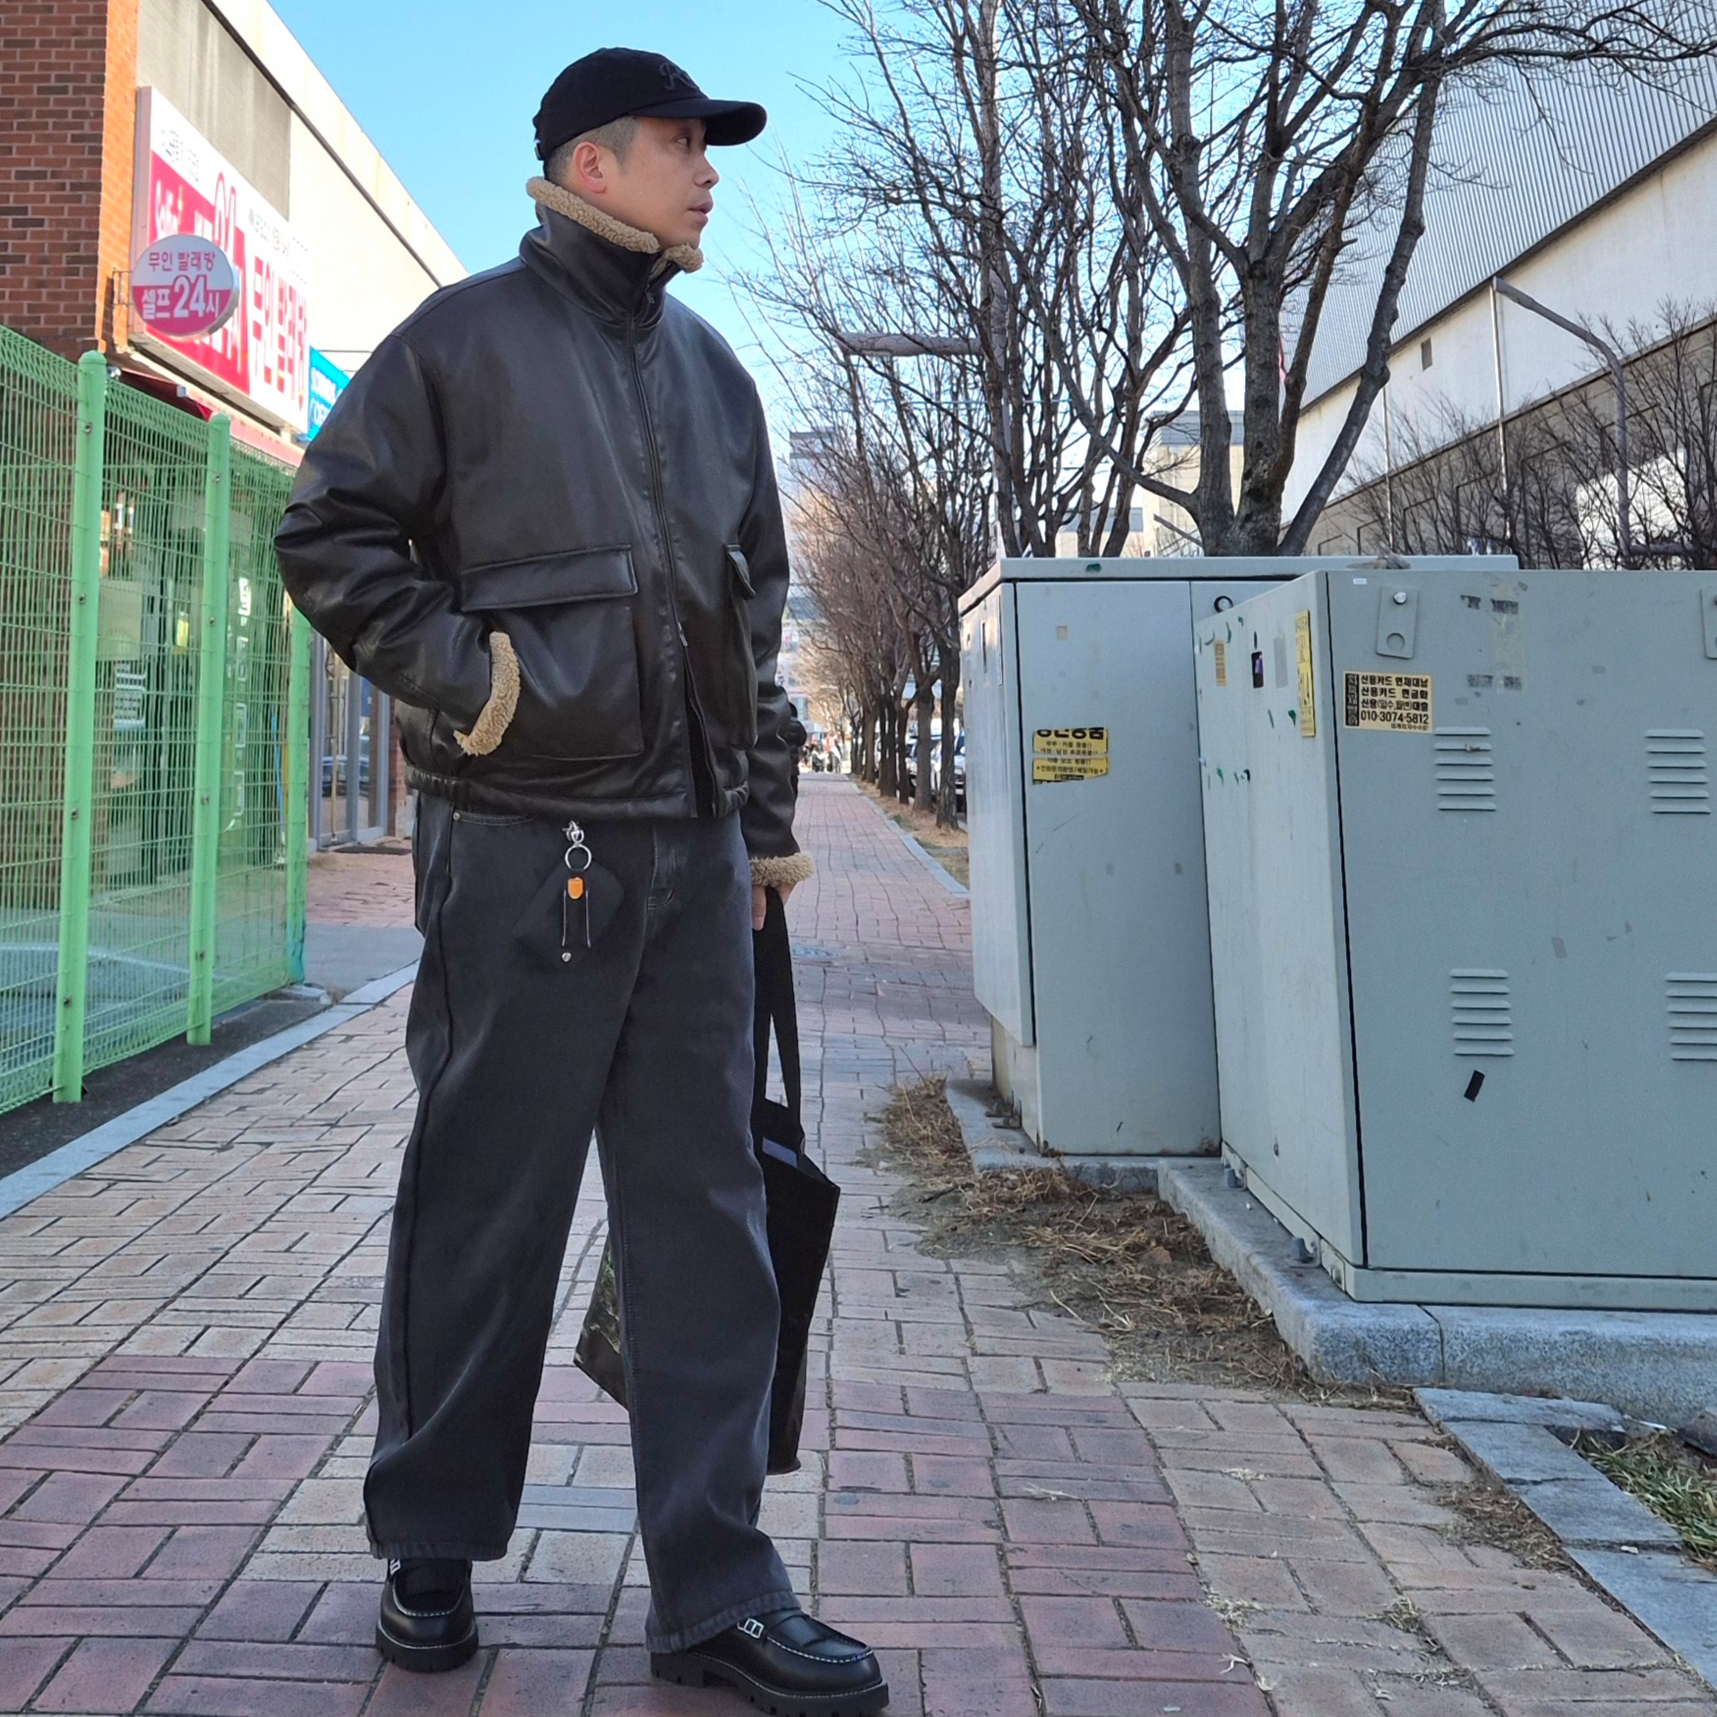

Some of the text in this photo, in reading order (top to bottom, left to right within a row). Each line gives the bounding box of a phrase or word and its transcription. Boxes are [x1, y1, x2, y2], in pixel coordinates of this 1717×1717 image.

[148, 251, 216, 272] 무인 빨래방
[141, 274, 220, 320] 셀프 24시
[252, 255, 307, 411] 무인 빨래방
[1361, 675, 1393, 686] 신용카드
[1361, 687, 1397, 698] 신용카드
[1360, 710, 1430, 724] 010-3074-5812
